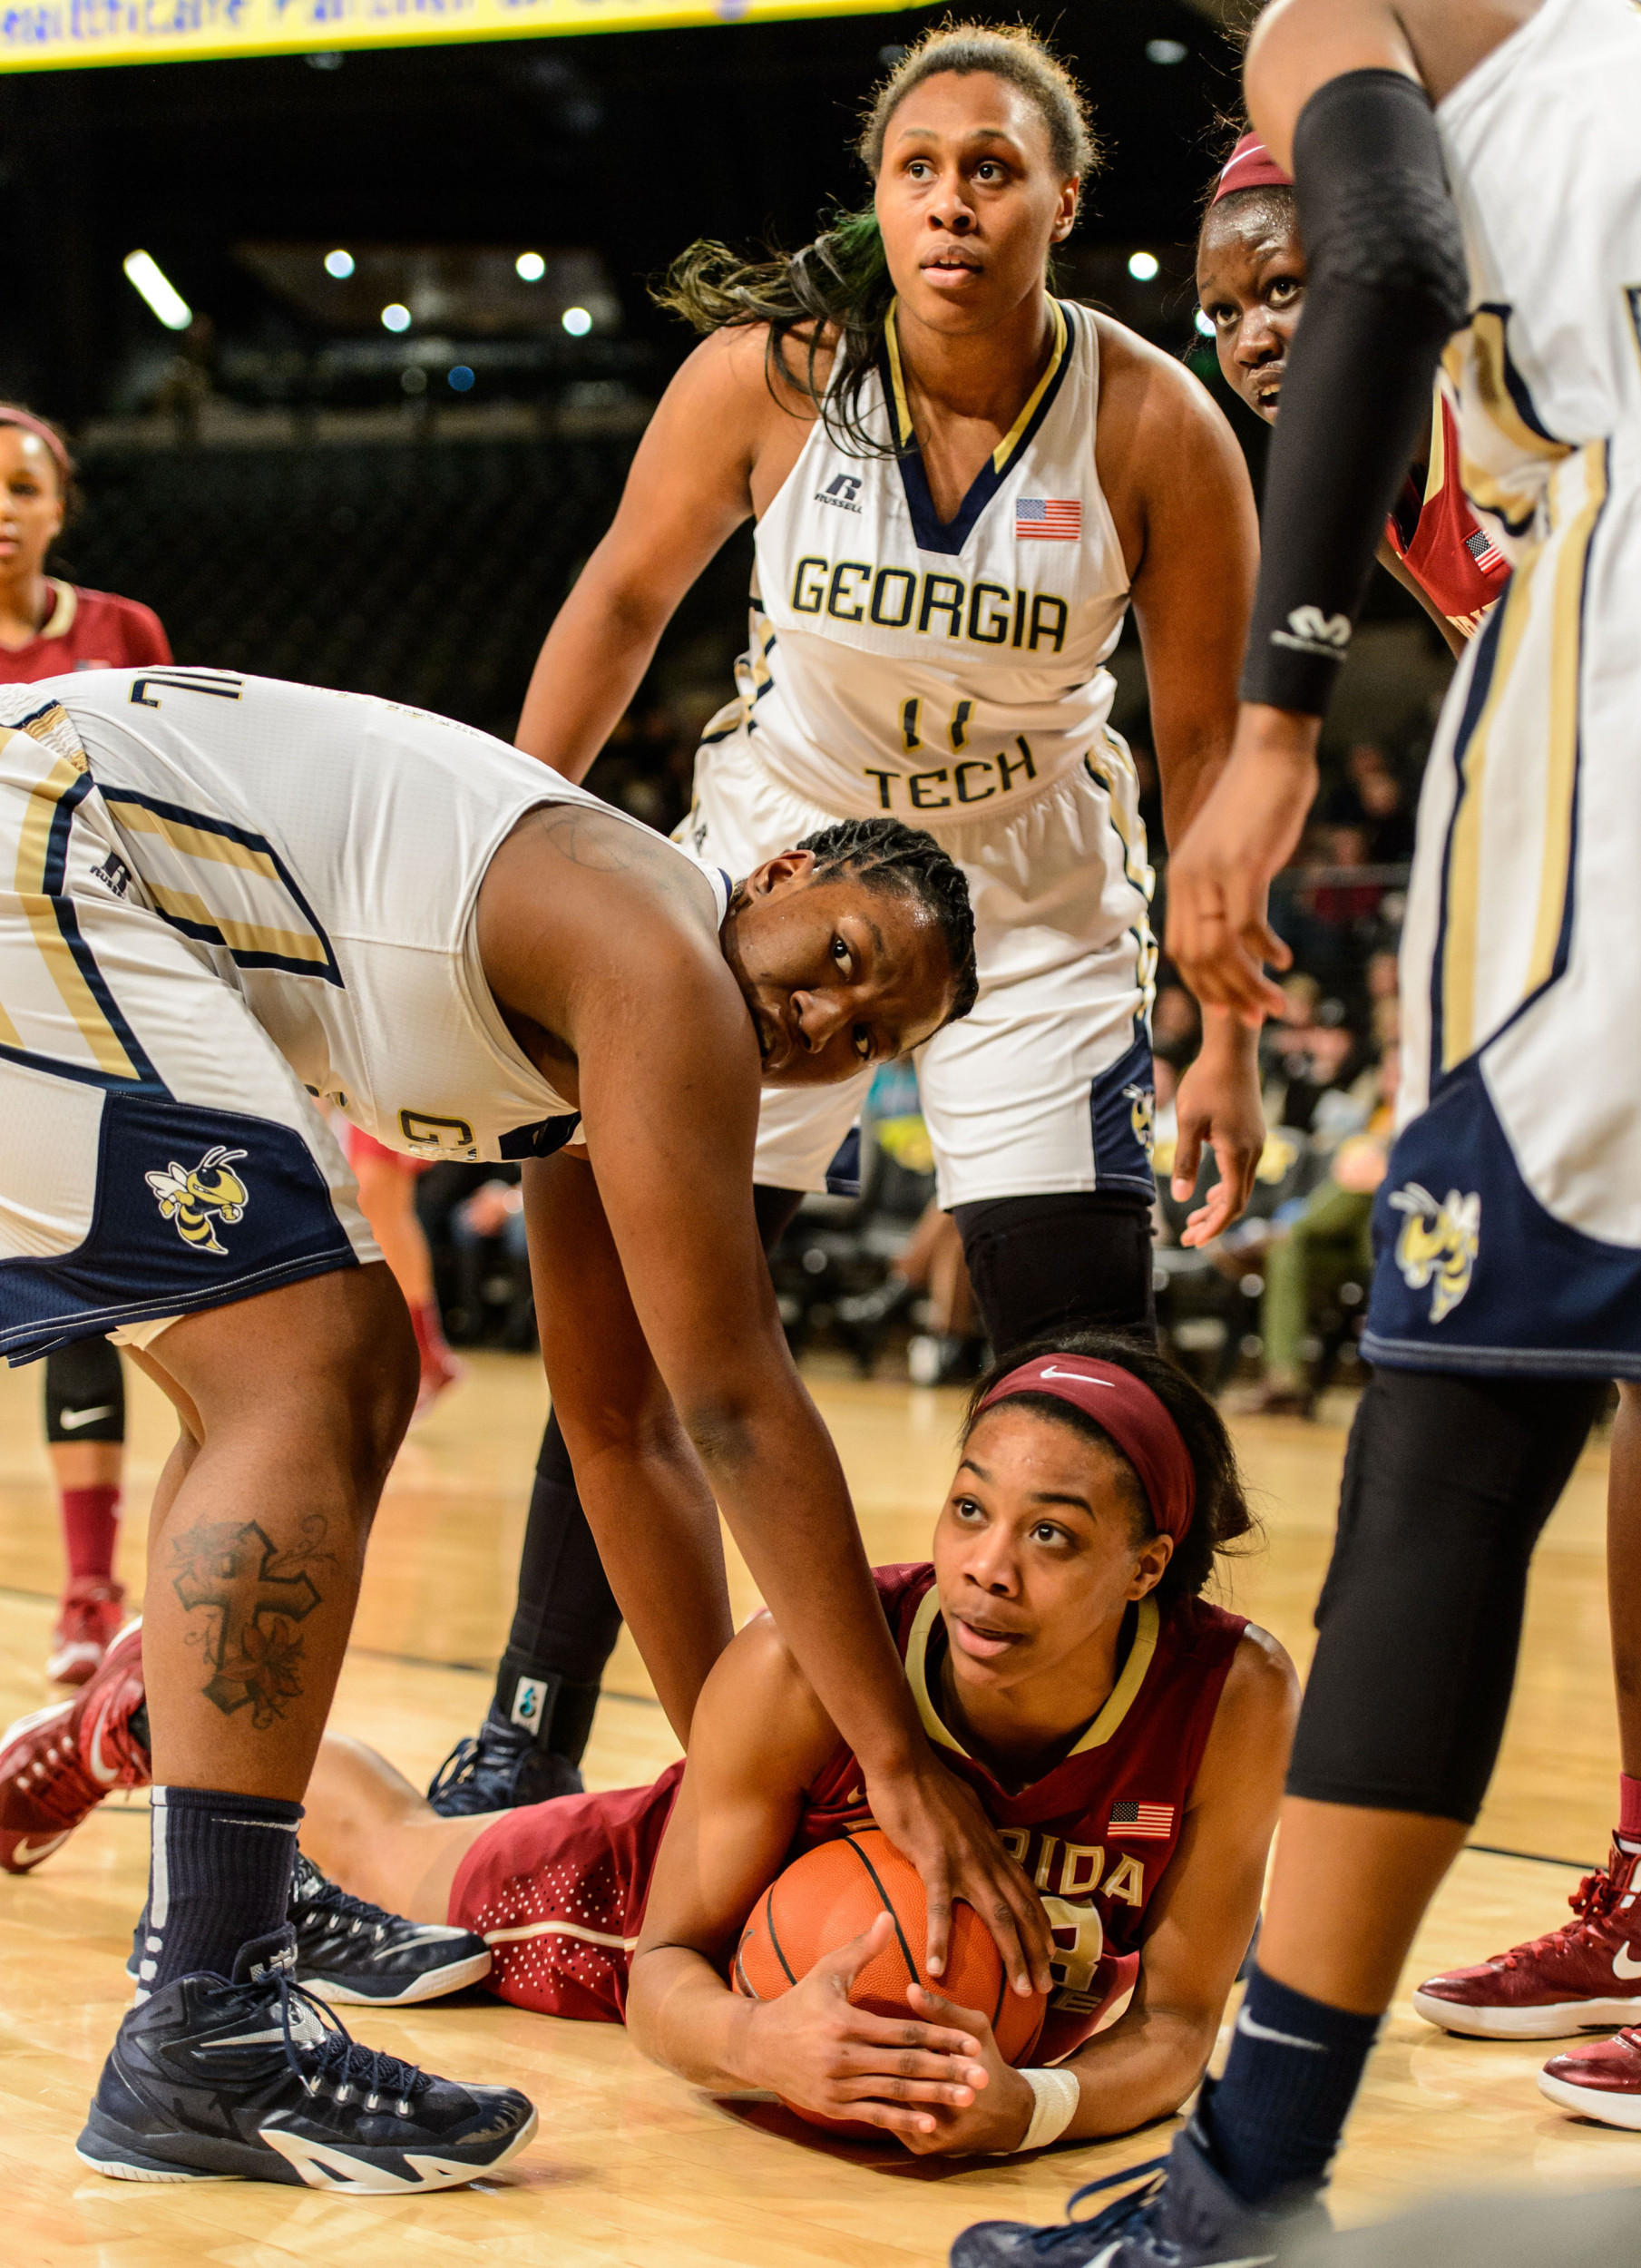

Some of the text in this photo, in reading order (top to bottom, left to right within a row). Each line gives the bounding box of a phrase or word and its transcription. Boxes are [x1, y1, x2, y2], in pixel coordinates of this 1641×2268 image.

[814, 493, 863, 514] RUSSELL
[791, 556, 1069, 653] GEORGIA
[864, 733, 1038, 810] TECH
